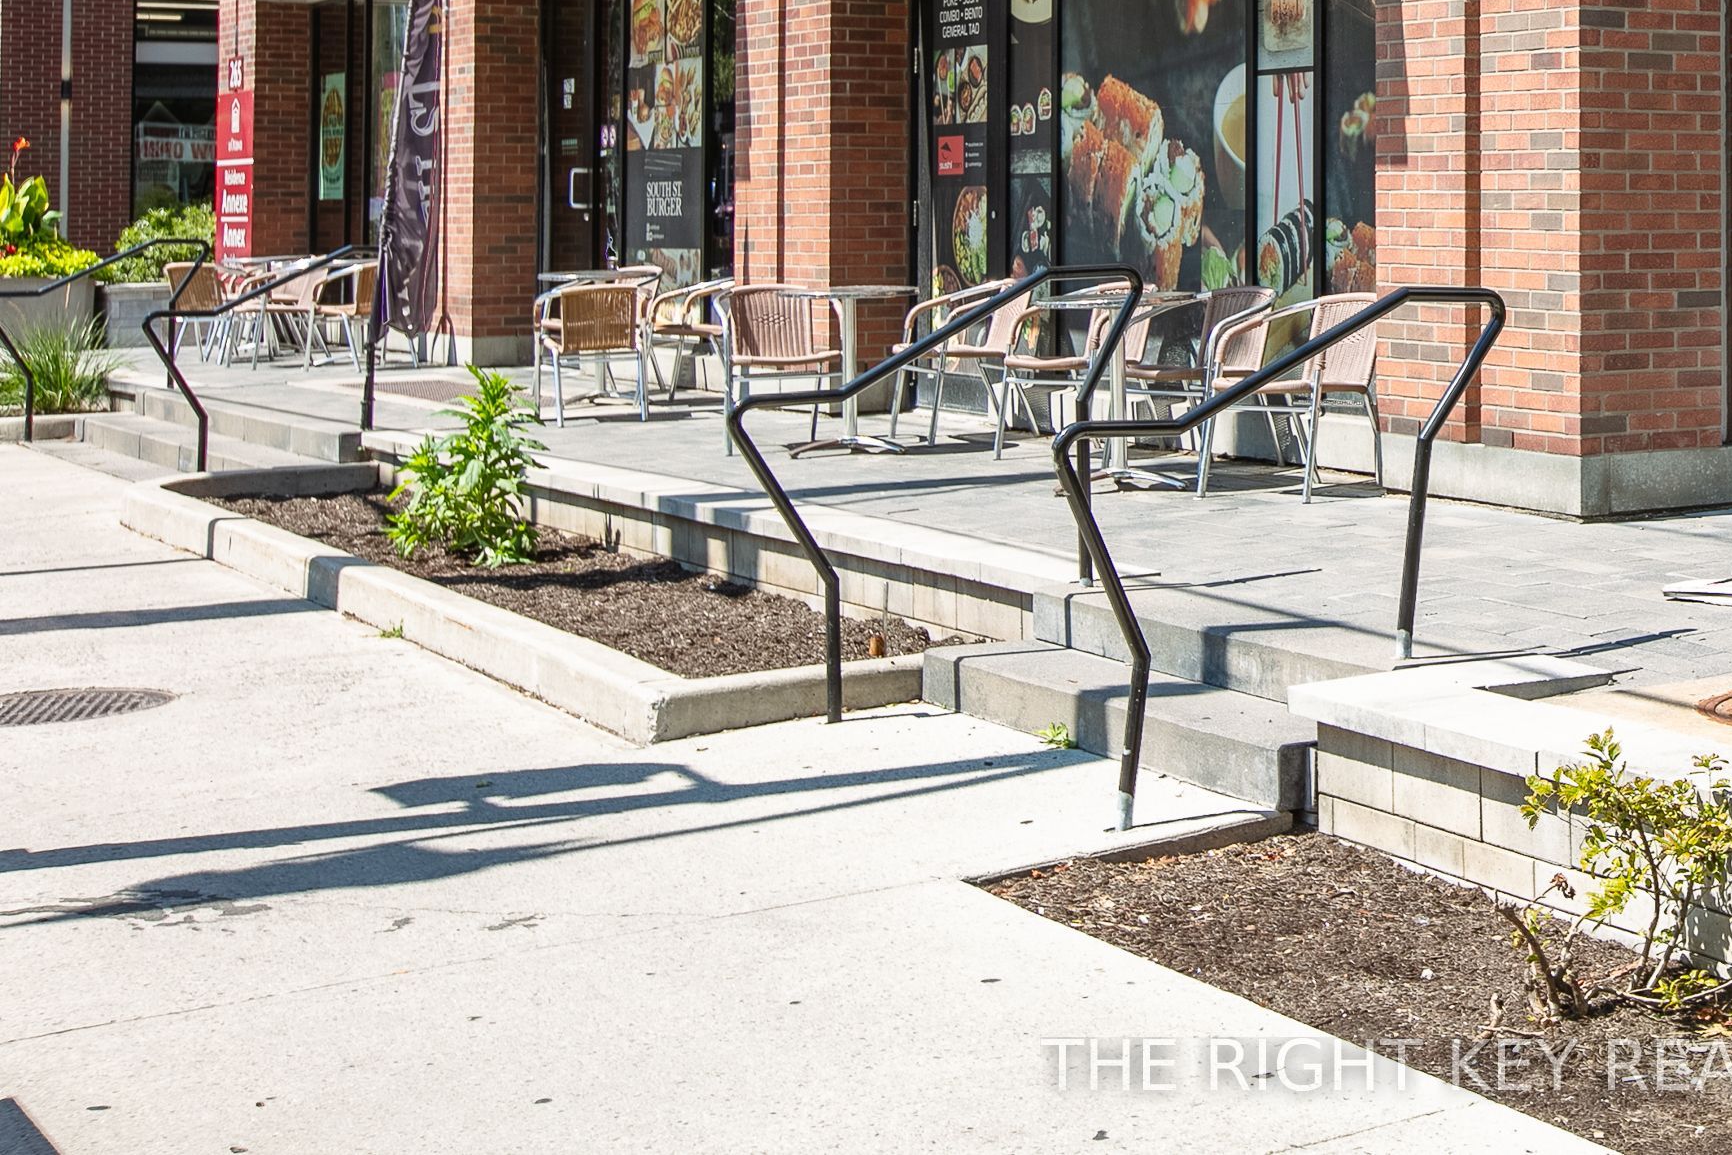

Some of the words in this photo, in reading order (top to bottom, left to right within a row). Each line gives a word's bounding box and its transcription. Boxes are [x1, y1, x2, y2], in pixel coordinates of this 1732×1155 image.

[940, 9, 960, 23] COMBO
[964, 6, 983, 20] BENTO
[942, 24, 968, 39] GENERAL
[646, 182, 671, 198] SOUTH
[221, 189, 248, 214] Annexe
[646, 197, 683, 217] BURGER
[222, 223, 246, 248] Annex
